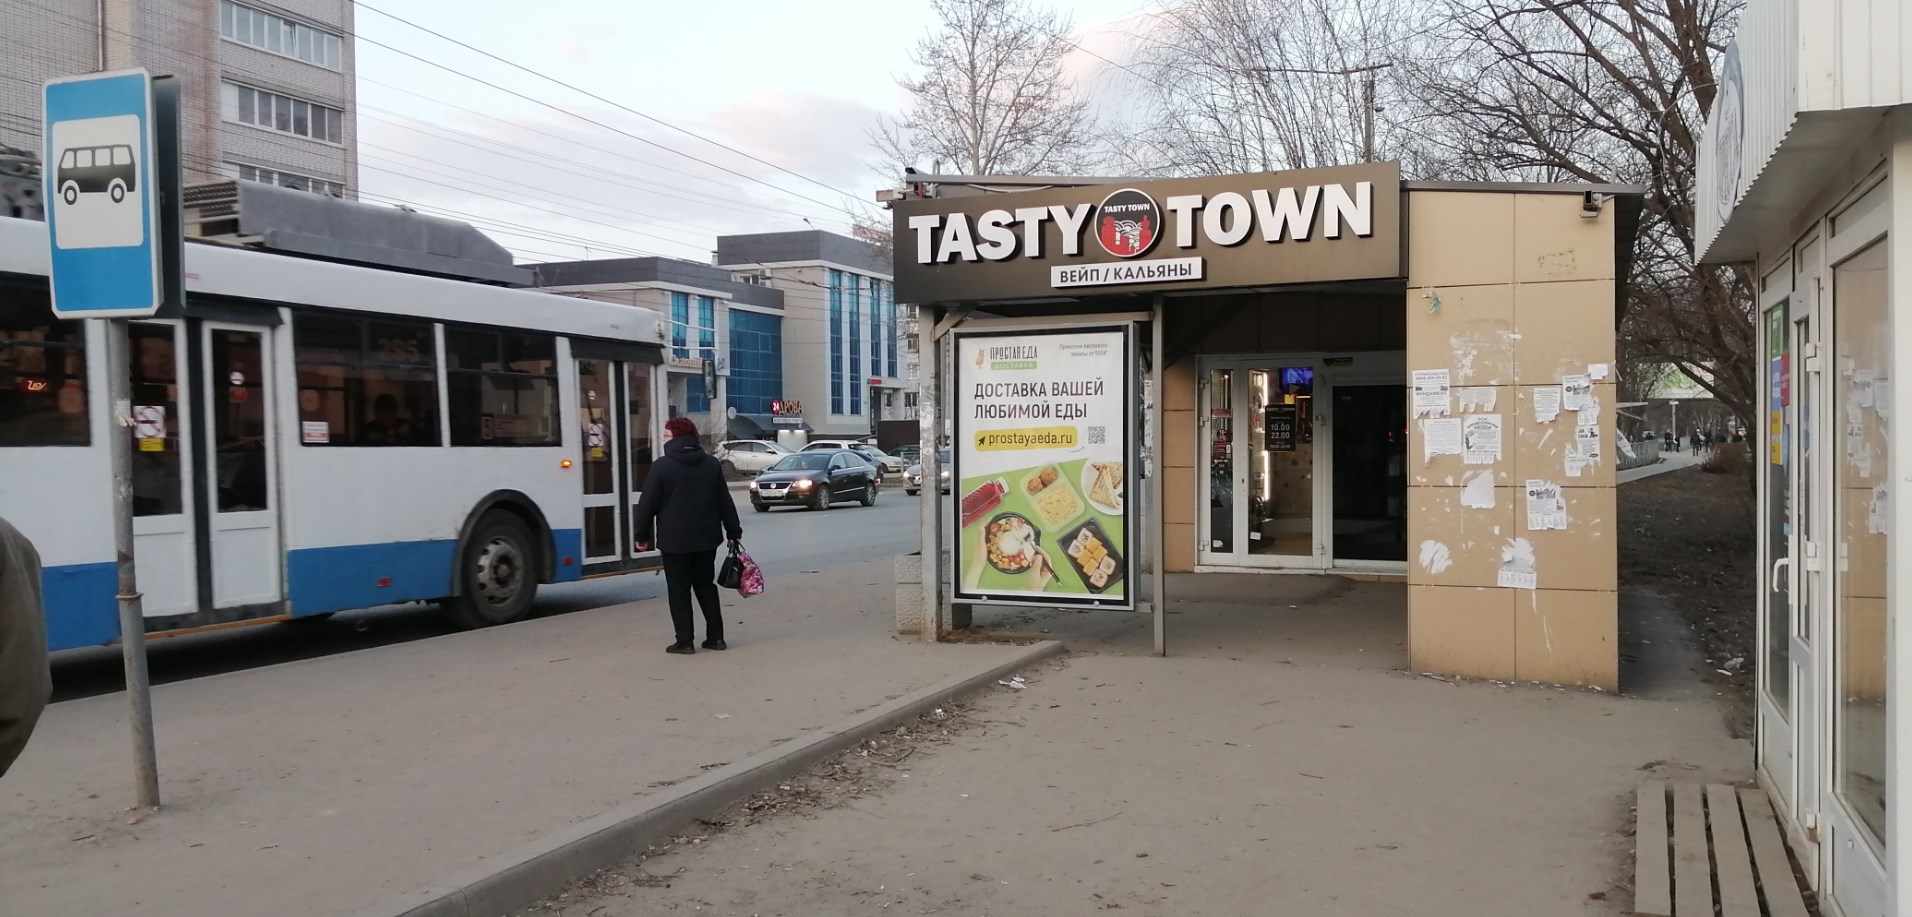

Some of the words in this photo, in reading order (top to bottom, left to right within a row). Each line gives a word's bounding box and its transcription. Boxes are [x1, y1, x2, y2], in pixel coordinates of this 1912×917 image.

[1104, 204, 1127, 213] TASTY
[1128, 203, 1150, 212] TOWN
[908, 203, 1093, 264] TASTY
[1166, 181, 1372, 247] TOWN
[1060, 266, 1100, 283] ВЕЙП
[1114, 262, 1192, 281] КАЛЬЯНЫ
[990, 346, 1021, 360] ПРОСТАЯ
[1022, 345, 1038, 359] ЕДА
[974, 382, 1047, 400] ДОСТАВКА
[1052, 376, 1104, 398] ВАШЕЙ
[772, 402, 780, 411] 24
[974, 400, 1050, 419] ЛЮБИМОЙ
[1055, 403, 1087, 420] ЕДЫ
[988, 432, 1073, 446] prostayaeda.ru
